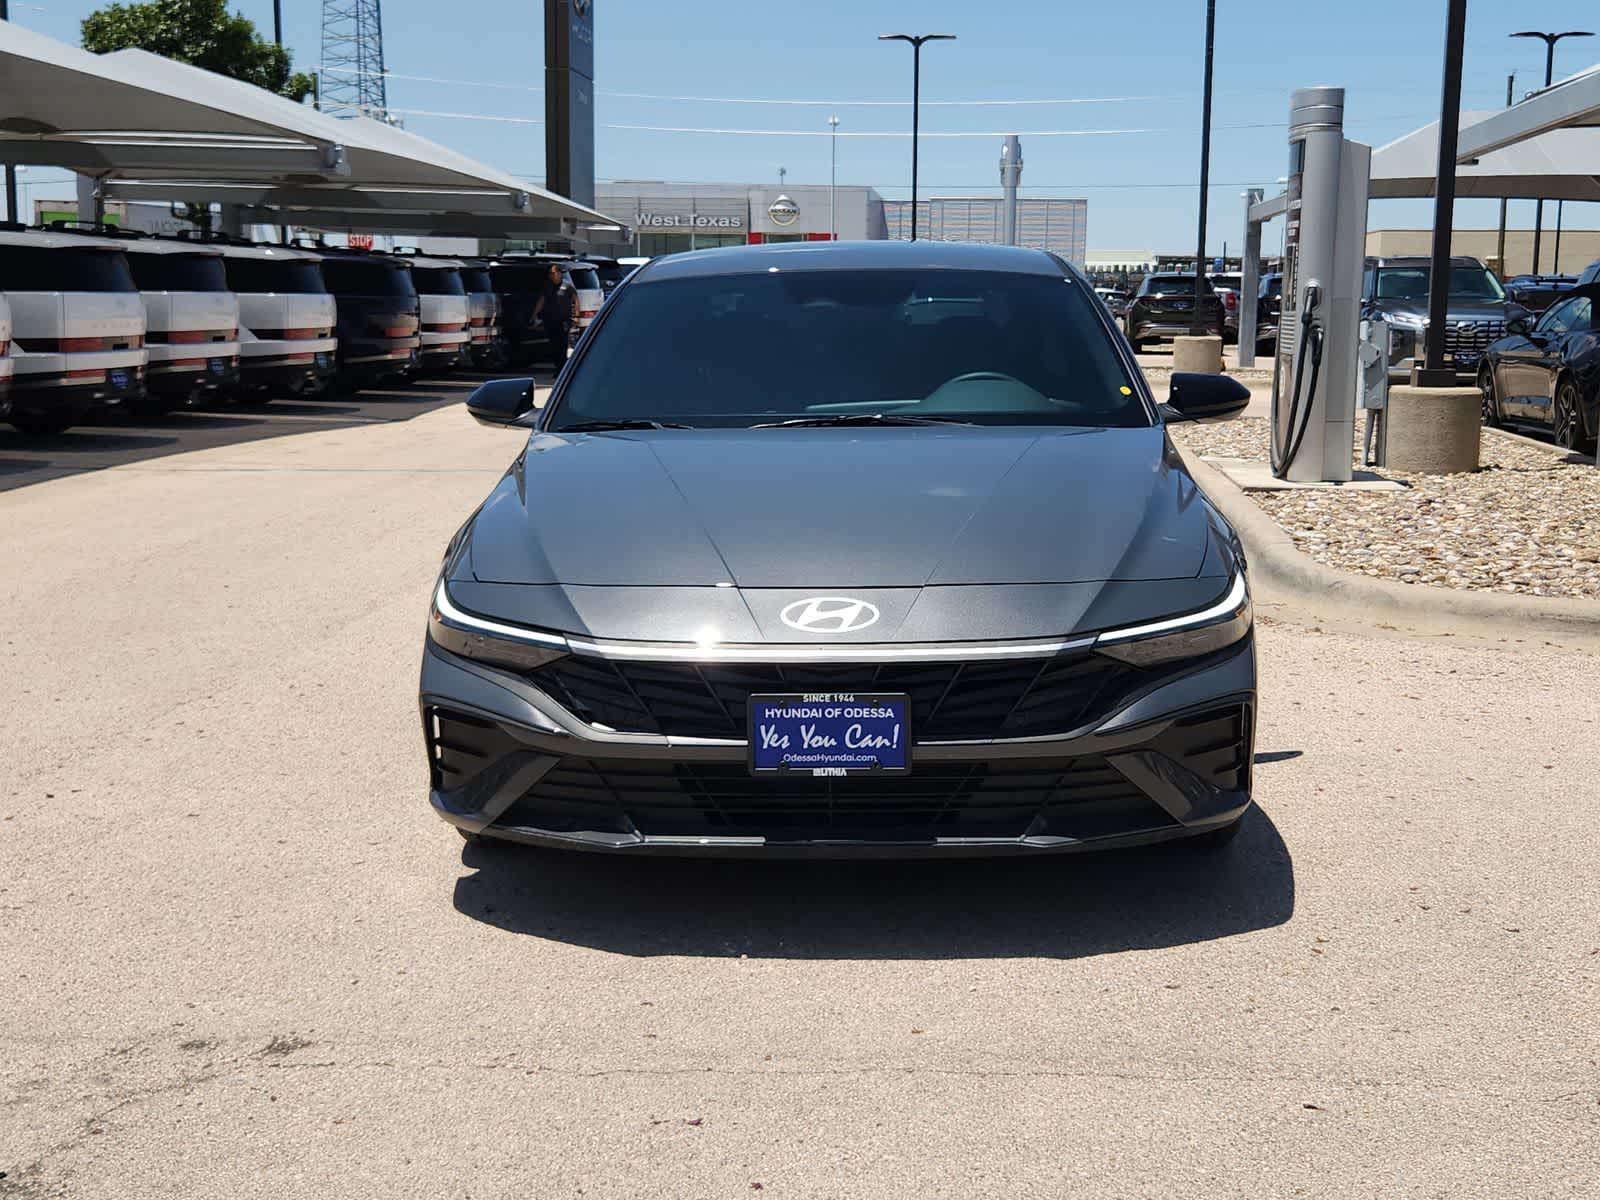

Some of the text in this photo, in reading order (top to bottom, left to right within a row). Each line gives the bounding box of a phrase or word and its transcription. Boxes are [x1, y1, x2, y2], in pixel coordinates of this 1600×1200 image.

[635, 214, 741, 227] West Texas
[350, 234, 372, 247] STOP
[803, 694, 855, 703] SINCE 1946
[765, 708, 895, 718] HYUNDAI OF ODESSA
[760, 723, 900, 749] Yes You Can!
[783, 753, 877, 762] OdessaHyundai.com
